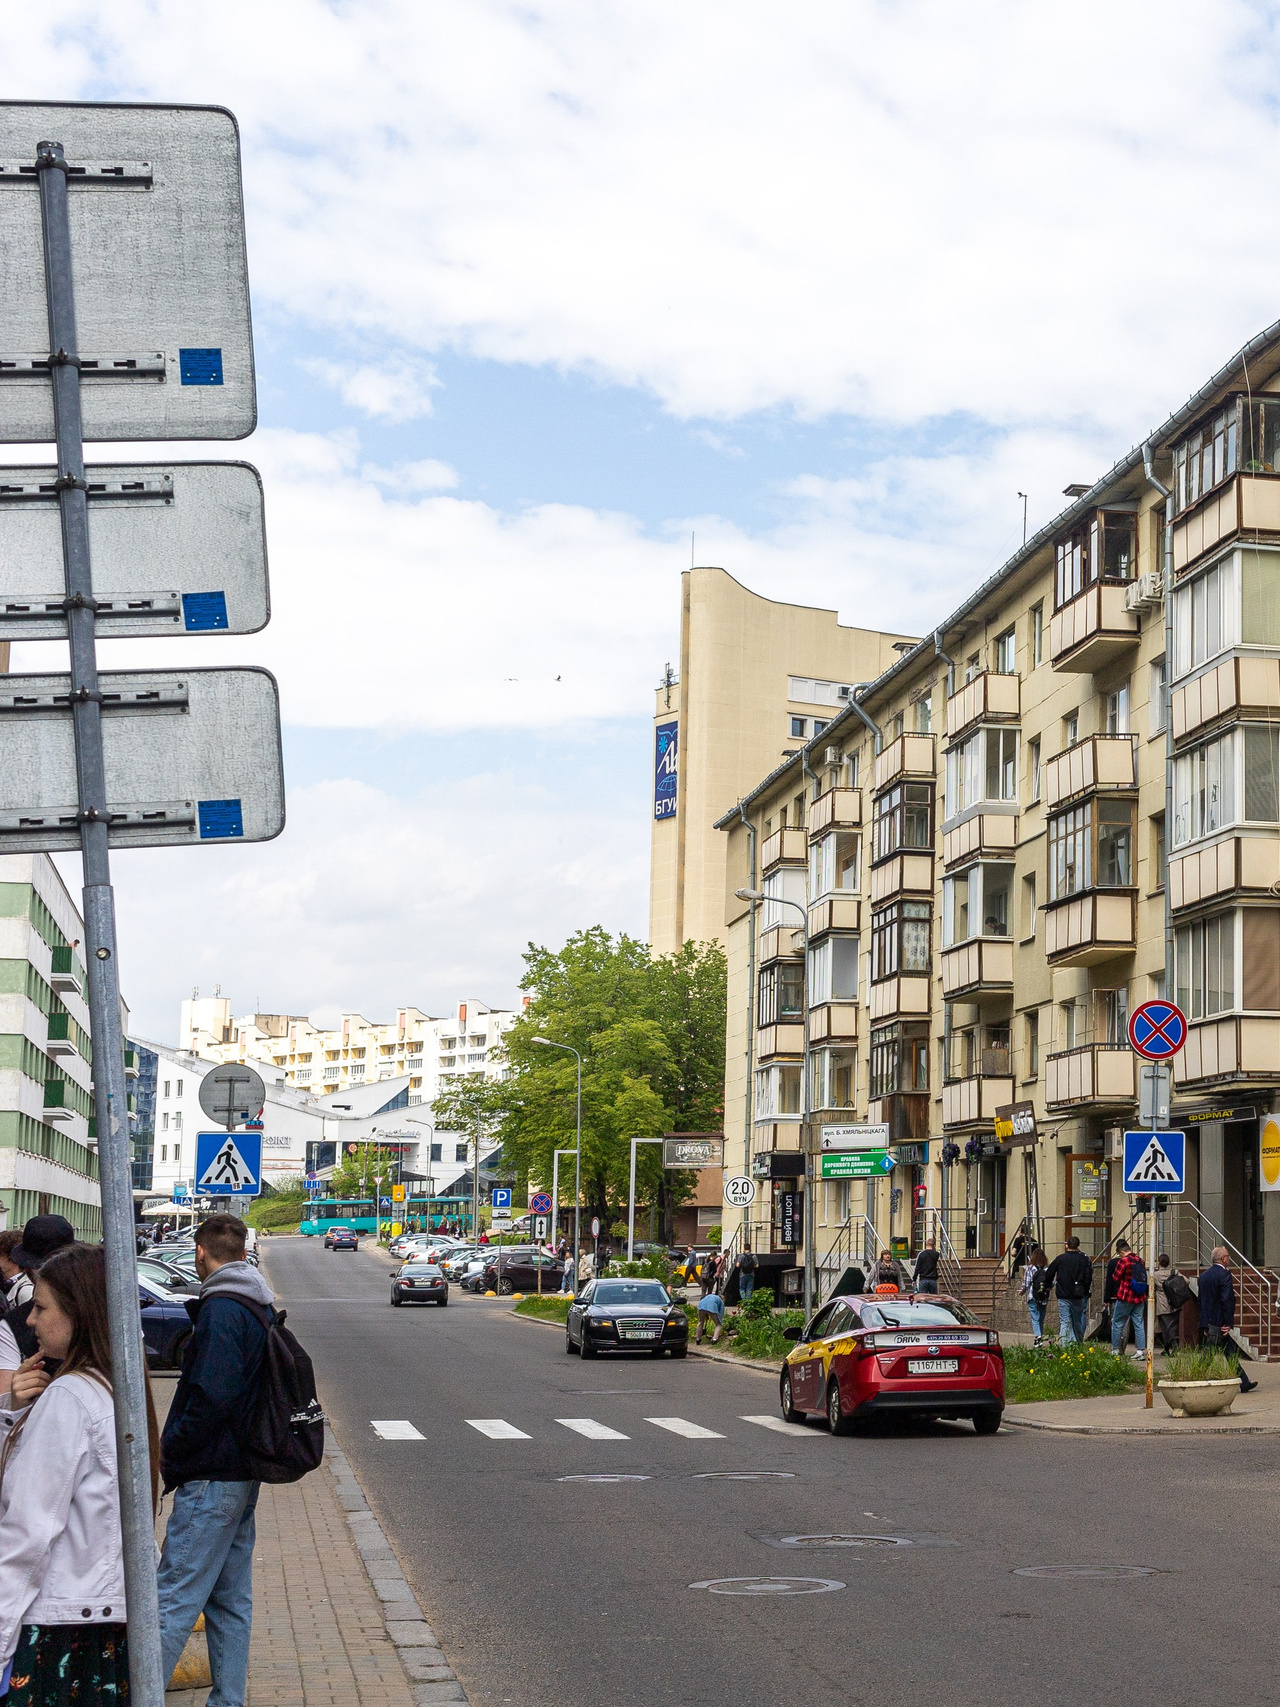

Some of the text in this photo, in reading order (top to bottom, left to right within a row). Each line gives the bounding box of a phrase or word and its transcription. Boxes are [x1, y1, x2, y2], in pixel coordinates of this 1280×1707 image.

[1189, 1110, 1234, 1121] ФОРМАТ
[678, 1146, 710, 1155] DROVA
[731, 1181, 749, 1198] 2,0
[497, 1191, 507, 1206] P
